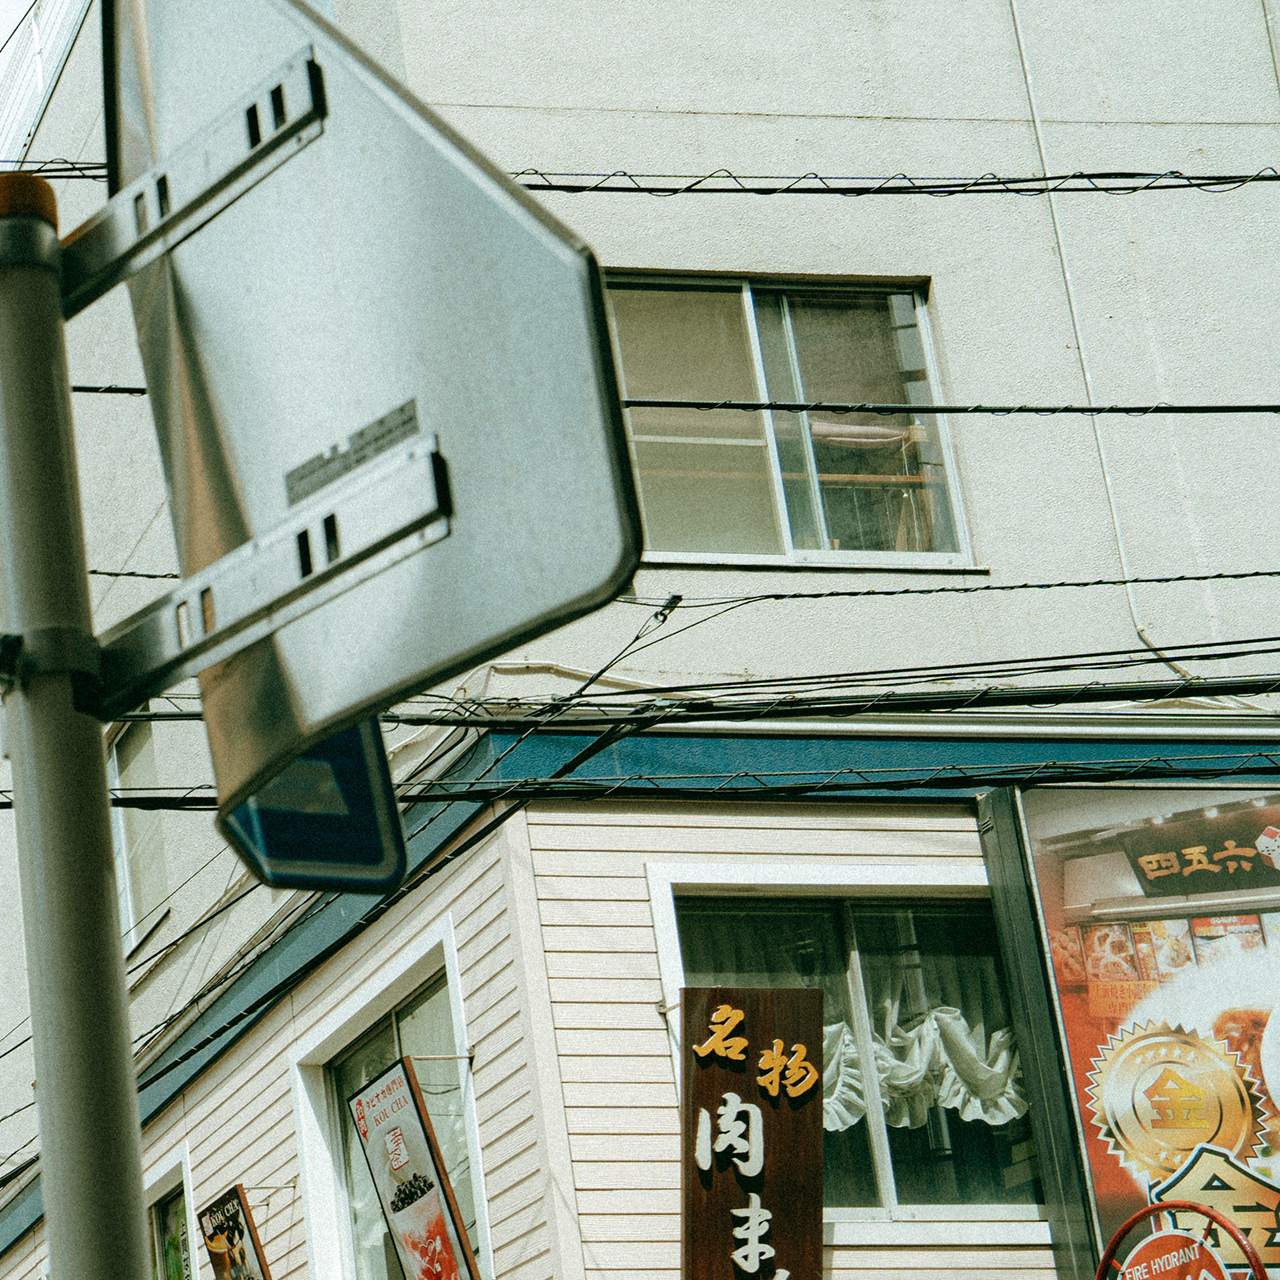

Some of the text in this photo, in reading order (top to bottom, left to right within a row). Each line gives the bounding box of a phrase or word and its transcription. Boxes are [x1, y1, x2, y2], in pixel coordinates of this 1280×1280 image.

[1137, 839, 1258, 880] 四五六
[692, 1004, 818, 1097] 名物
[365, 1074, 405, 1112] タピオカ専門店
[373, 1094, 409, 1126] KOU CHA
[1143, 1067, 1210, 1129] 金
[211, 1199, 239, 1228] KOU CHA
[1151, 1242, 1200, 1273] HYDRANT
